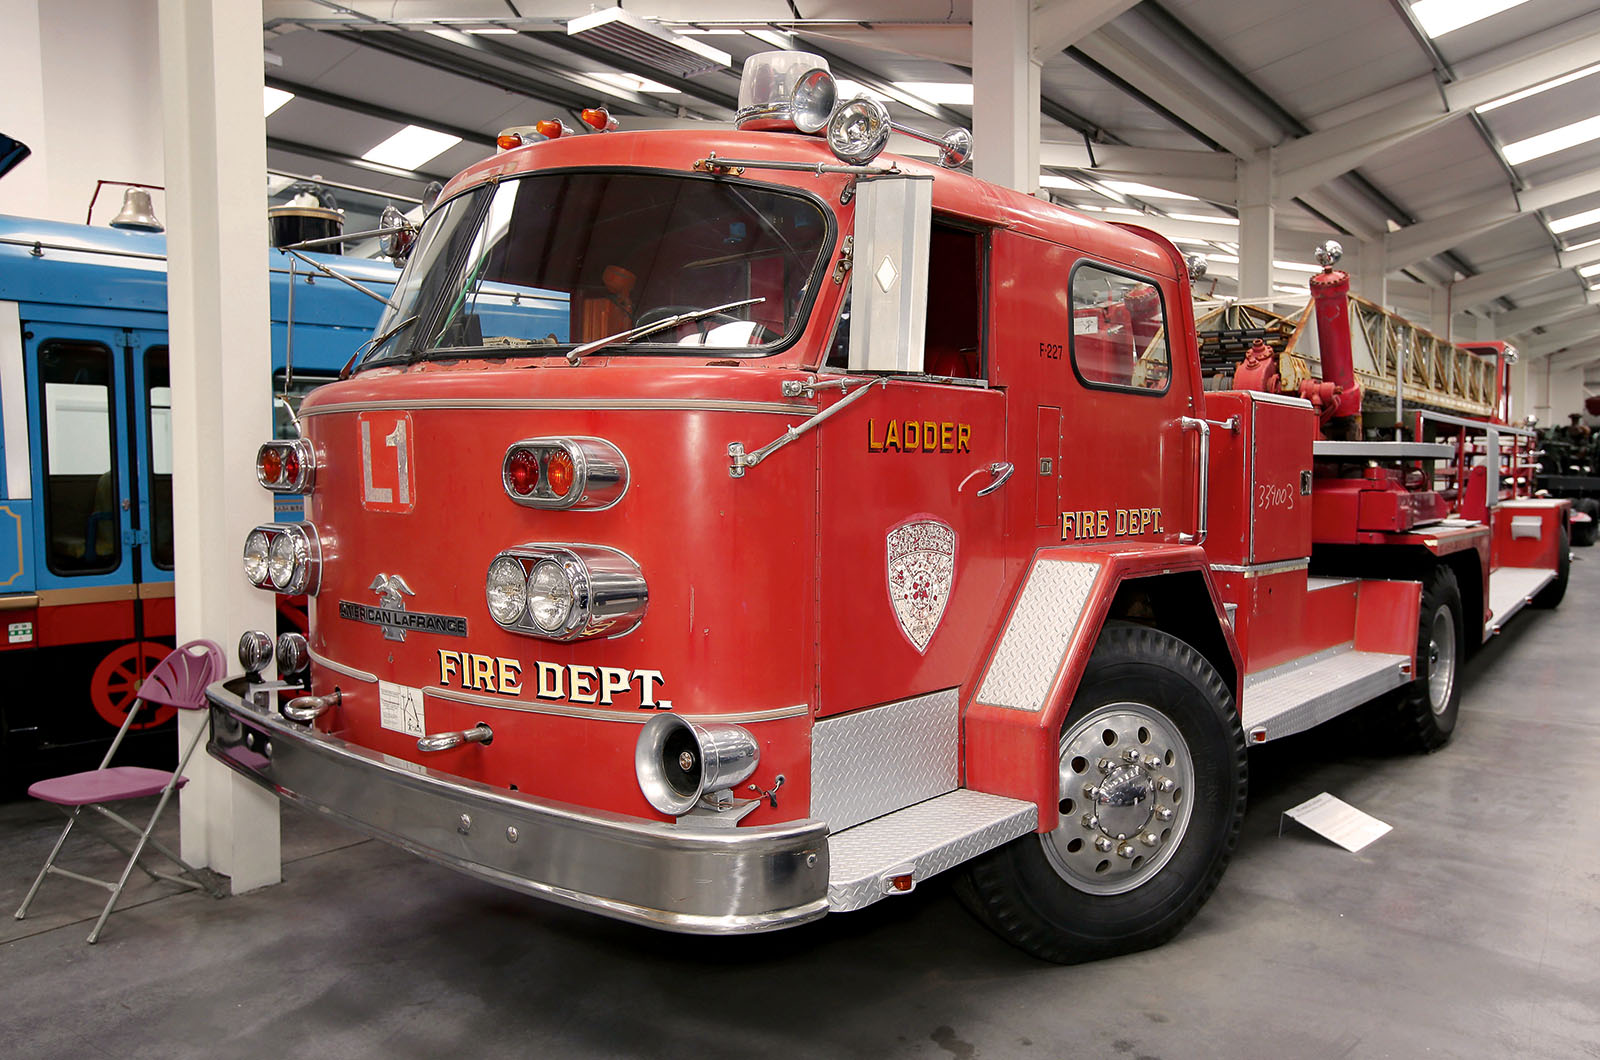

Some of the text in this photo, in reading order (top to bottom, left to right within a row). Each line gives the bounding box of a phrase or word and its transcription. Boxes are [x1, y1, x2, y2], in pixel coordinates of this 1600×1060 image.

[867, 418, 971, 454] LADDER
[361, 419, 410, 504] L1
[1060, 507, 1164, 541] FIRE DEPT.
[339, 602, 392, 624] AMERICAN
[437, 648, 673, 710] FIRE DEPT.
